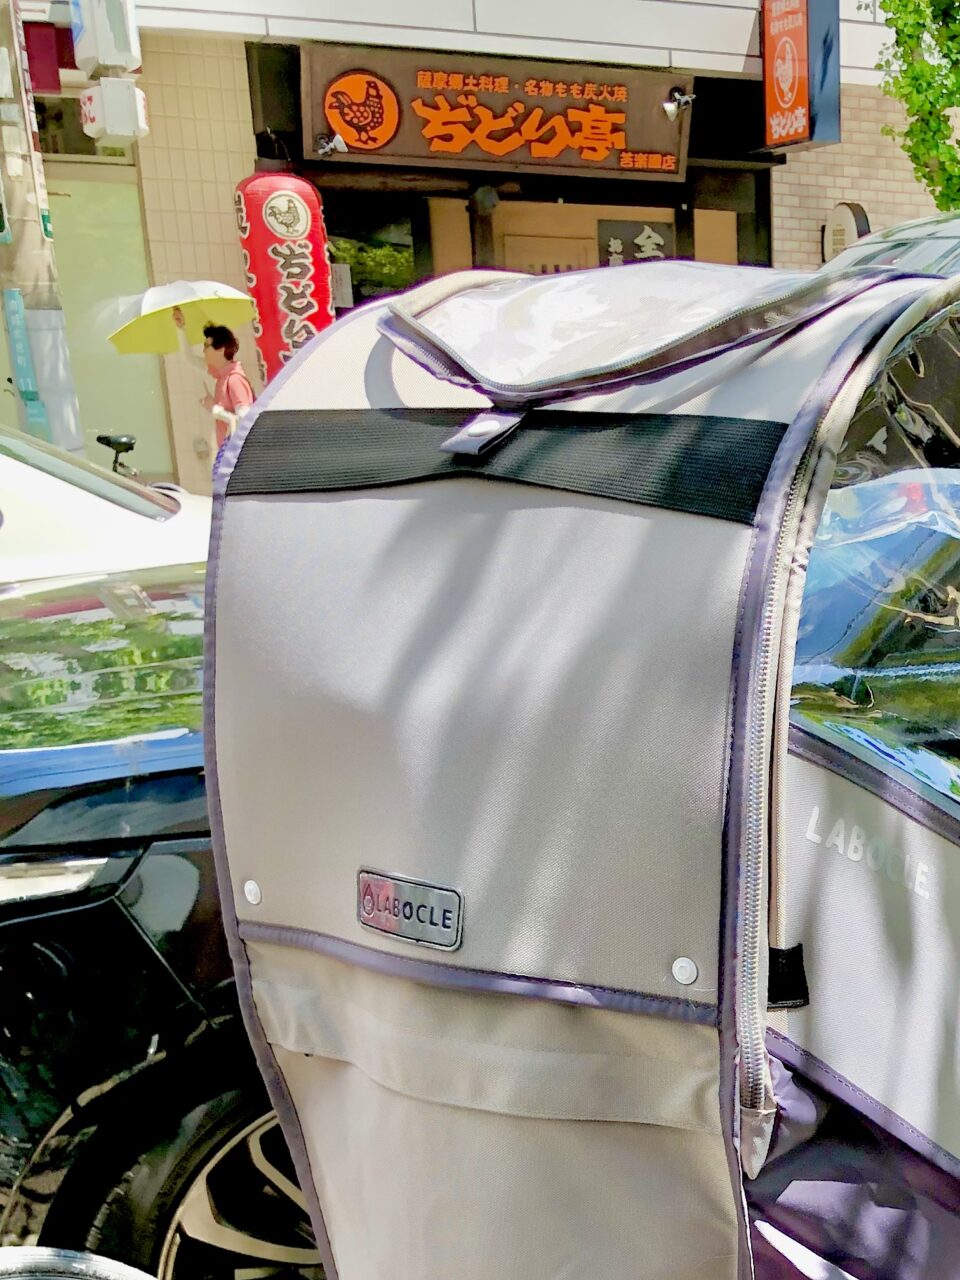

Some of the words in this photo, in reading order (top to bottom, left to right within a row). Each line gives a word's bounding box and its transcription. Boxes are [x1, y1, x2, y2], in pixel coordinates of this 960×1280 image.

[411, 95, 626, 160] ぢどり亭
[269, 242, 317, 363] ぢどり
[806, 806, 931, 898] LABOCLE
[376, 894, 453, 929] LABOCLE
